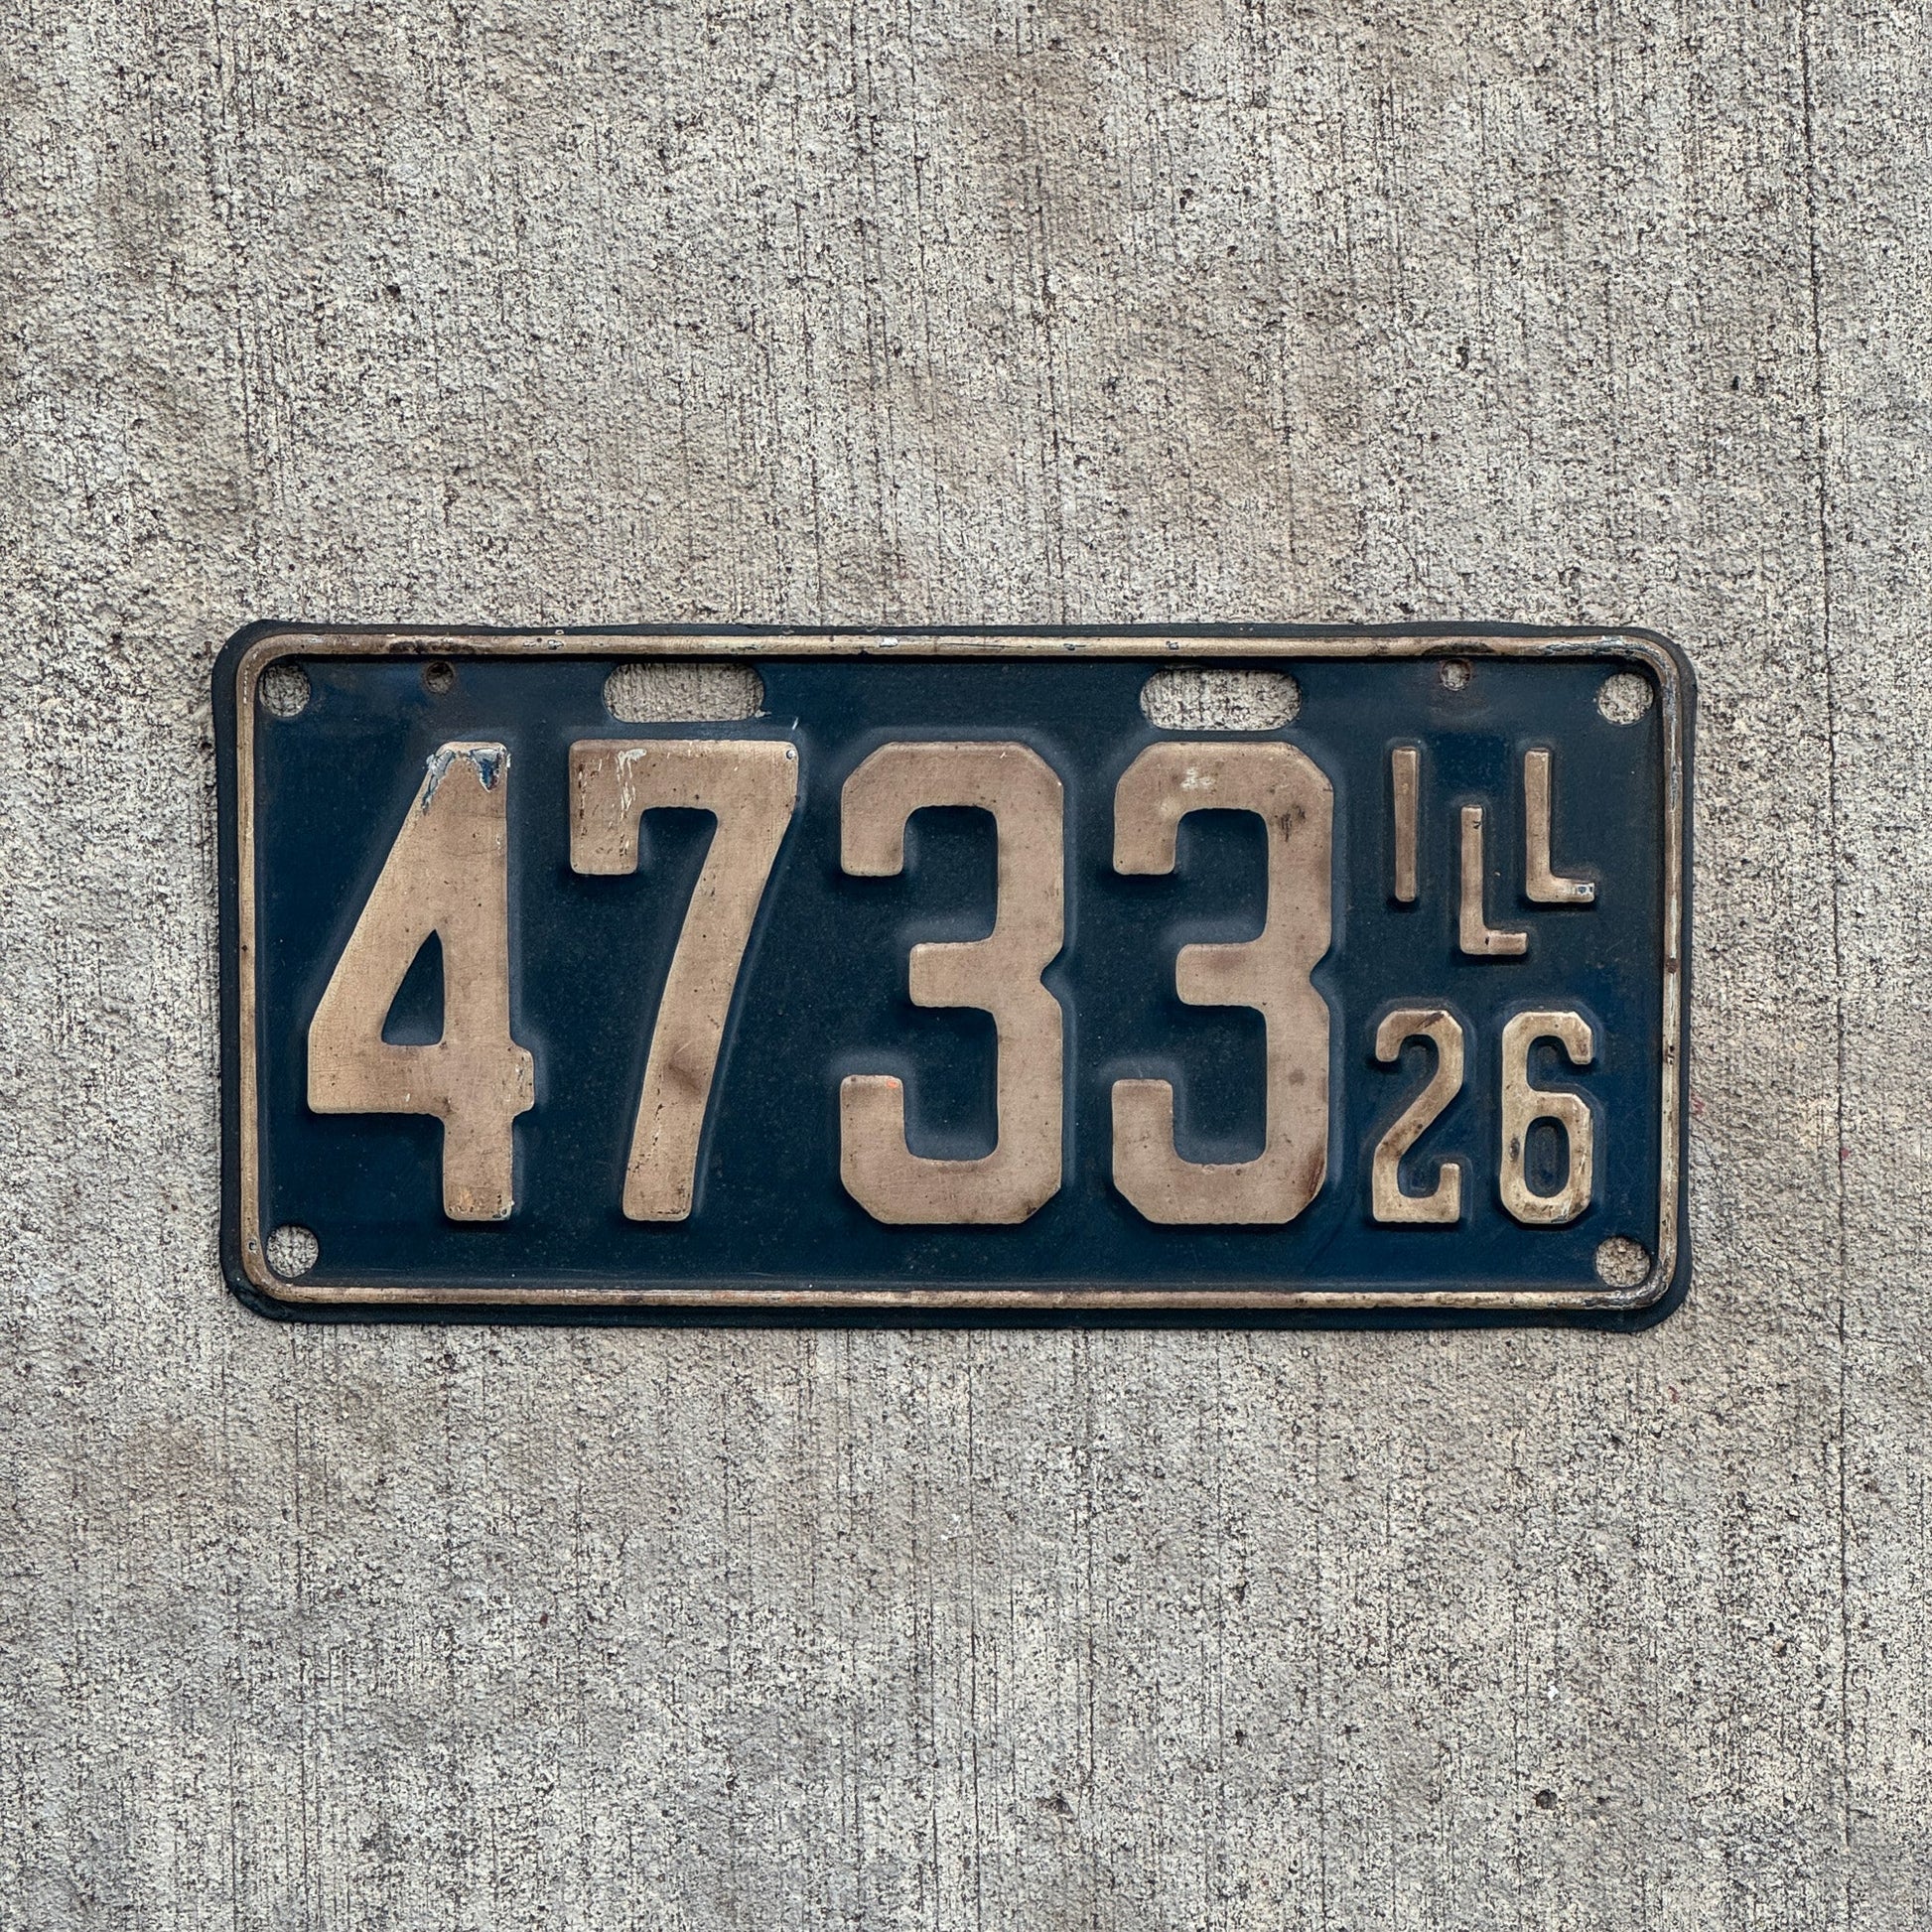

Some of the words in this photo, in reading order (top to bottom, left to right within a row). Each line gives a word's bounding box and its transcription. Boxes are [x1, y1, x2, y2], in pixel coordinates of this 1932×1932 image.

[1391, 747, 1595, 955] ILL
[307, 740, 1334, 1226] 4733
[1372, 1009, 1594, 1224] 26
